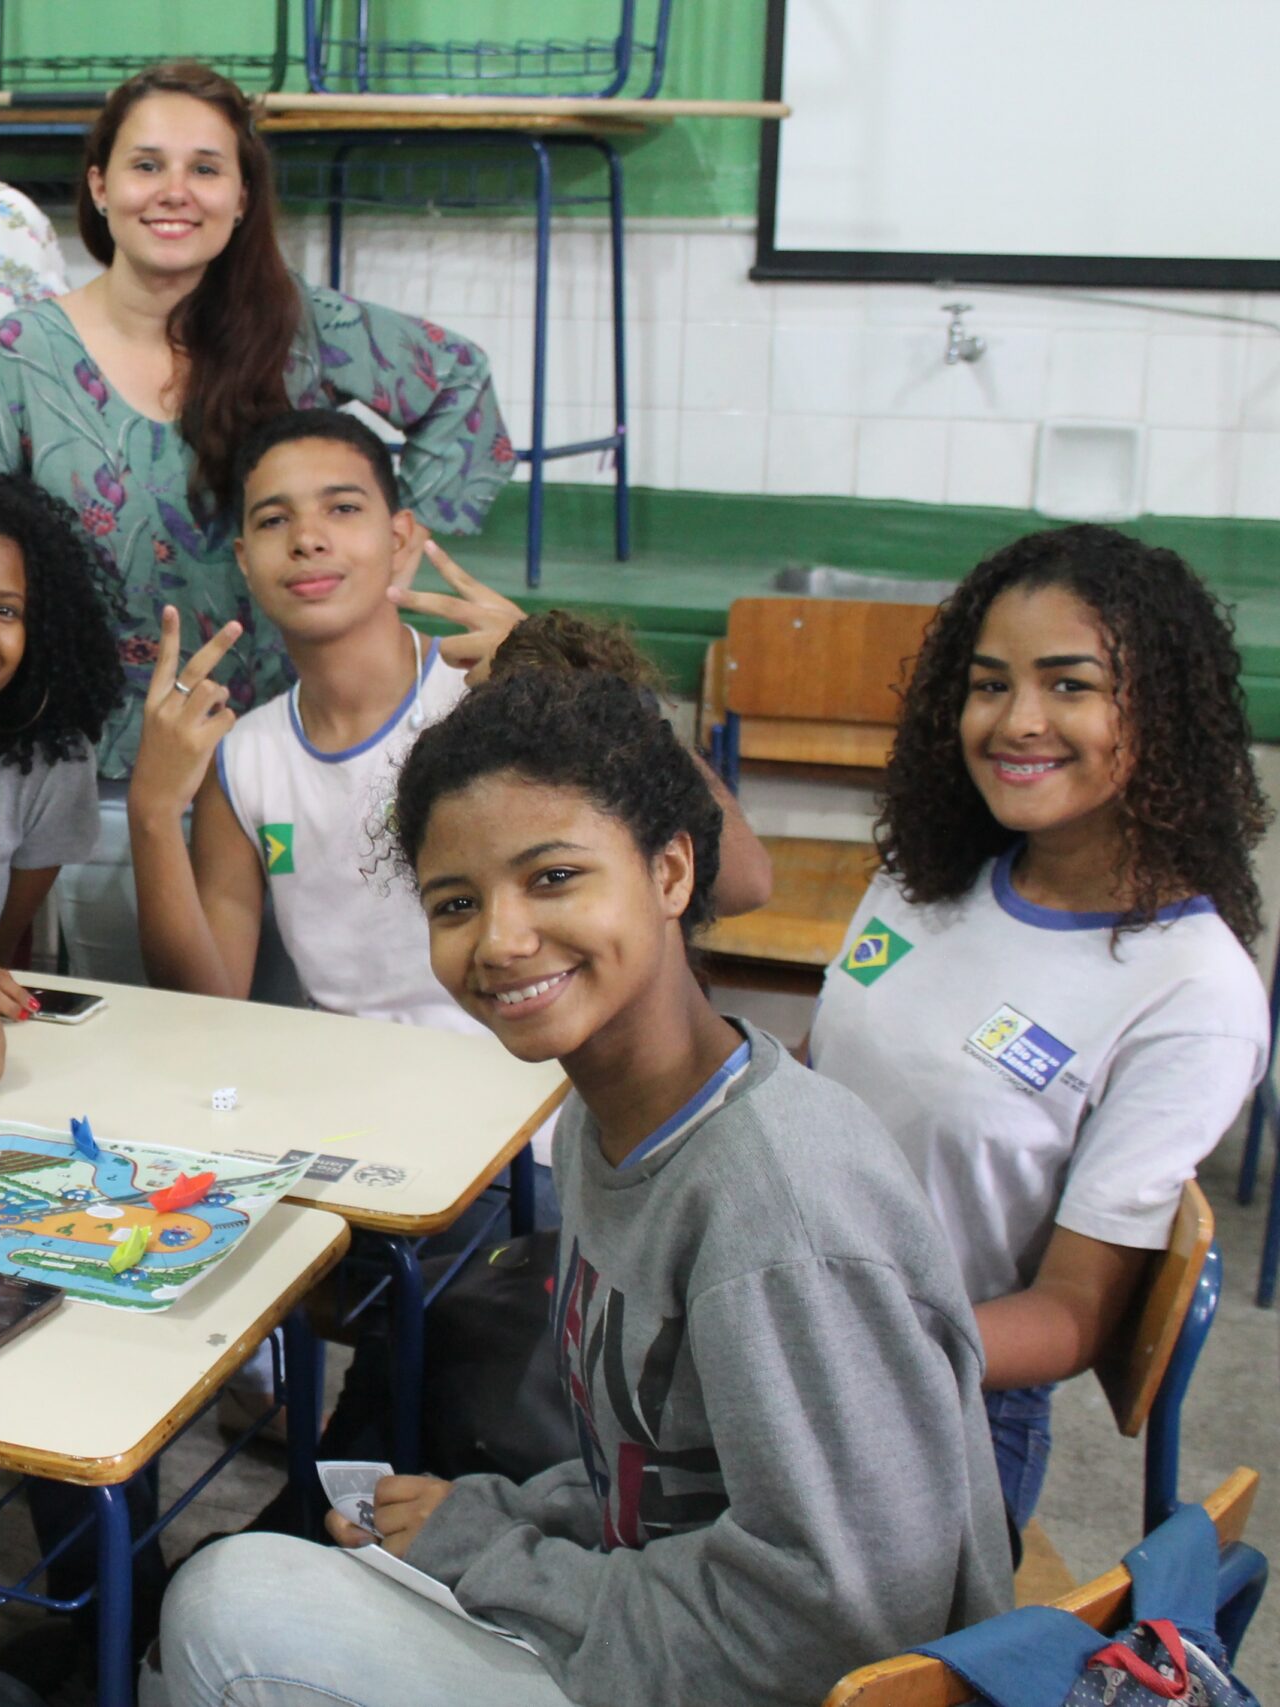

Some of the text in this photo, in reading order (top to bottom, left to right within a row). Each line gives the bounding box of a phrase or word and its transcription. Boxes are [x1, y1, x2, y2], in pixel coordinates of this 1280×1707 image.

[1000, 1051, 1047, 1086] Janeiro
[1009, 1041, 1031, 1061] Rio
[1030, 1057, 1049, 1073] de
